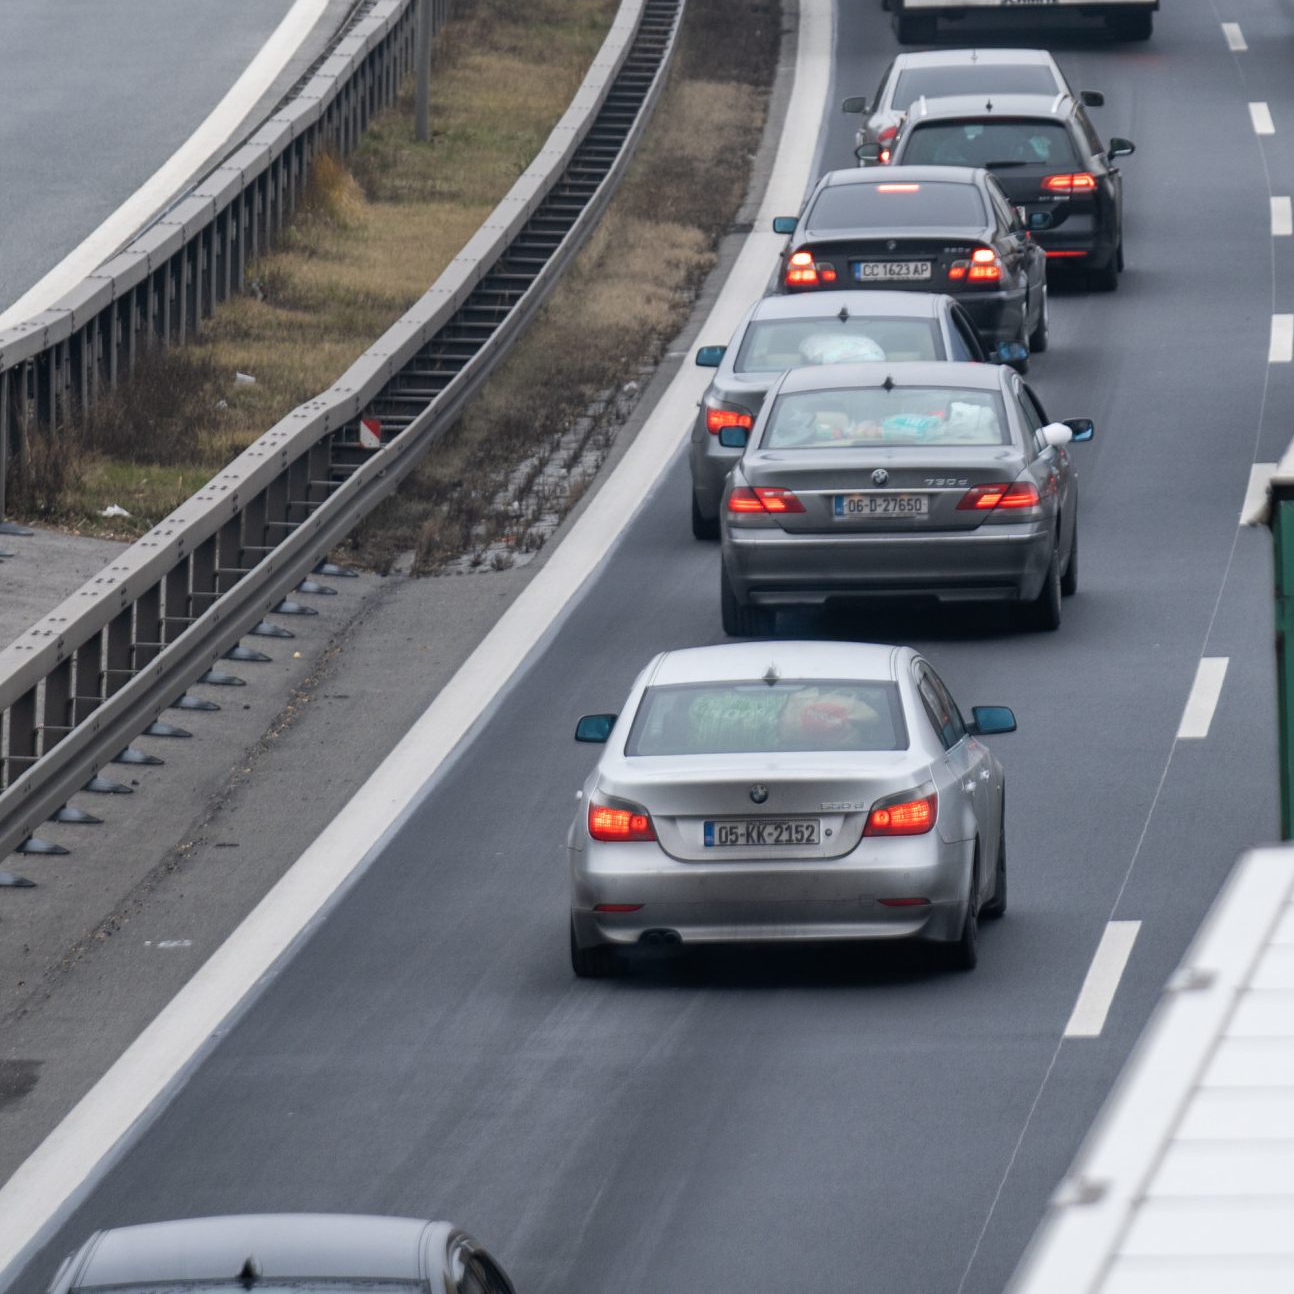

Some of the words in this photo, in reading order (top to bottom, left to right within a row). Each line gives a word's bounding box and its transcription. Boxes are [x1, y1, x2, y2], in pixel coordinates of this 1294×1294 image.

[863, 264, 879, 276] CC
[882, 264, 910, 277] 1623
[912, 263, 929, 275] AP
[848, 498, 922, 513] 06-D-27650
[718, 824, 815, 845] 05-KK-2152
